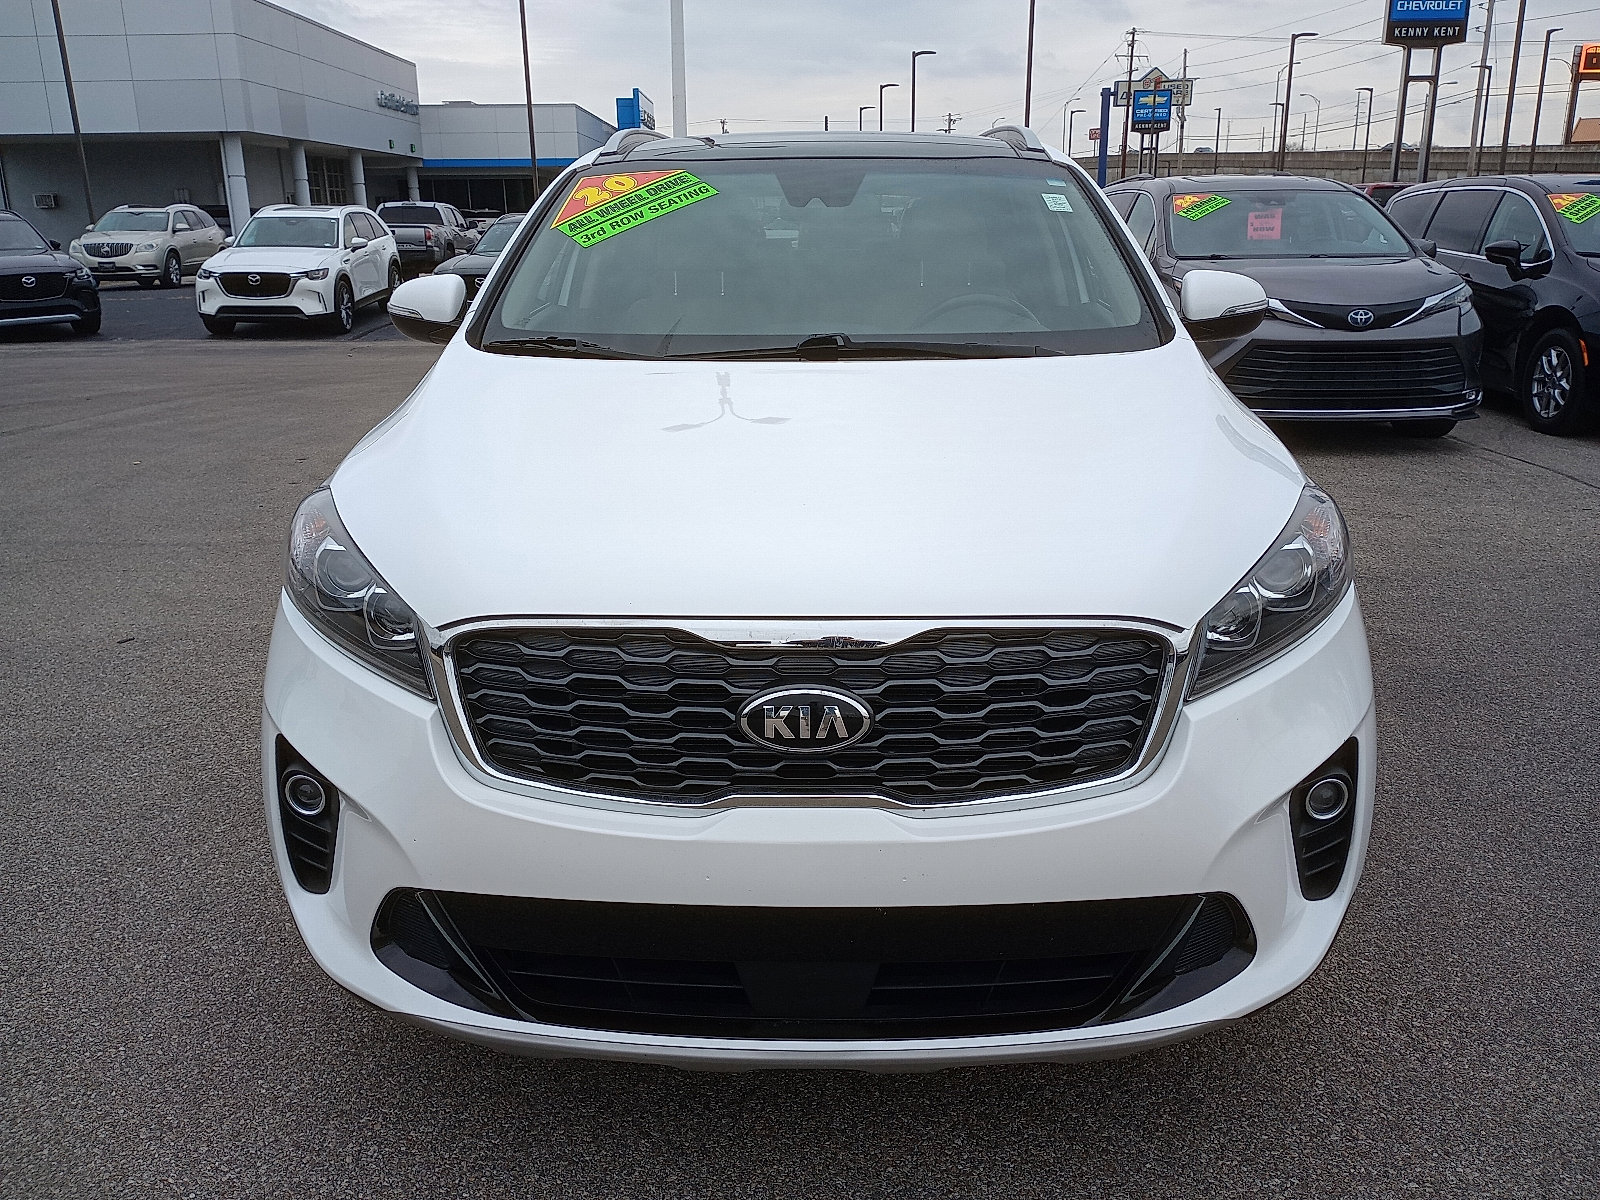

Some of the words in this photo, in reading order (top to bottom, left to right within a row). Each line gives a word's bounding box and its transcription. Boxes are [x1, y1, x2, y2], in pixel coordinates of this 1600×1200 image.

[1396, 0, 1464, 11] CHEVROLET
[1394, 27, 1429, 37] KENNY
[1433, 26, 1460, 36] KENT
[568, 213, 598, 234] ALL
[595, 193, 649, 218] WHEEL
[645, 174, 692, 197] DRIVE
[573, 174, 638, 207] 20
[580, 227, 606, 244] 3rd
[609, 210, 645, 231] ROW
[648, 185, 711, 215] SEATING
[762, 705, 849, 739] KIA
